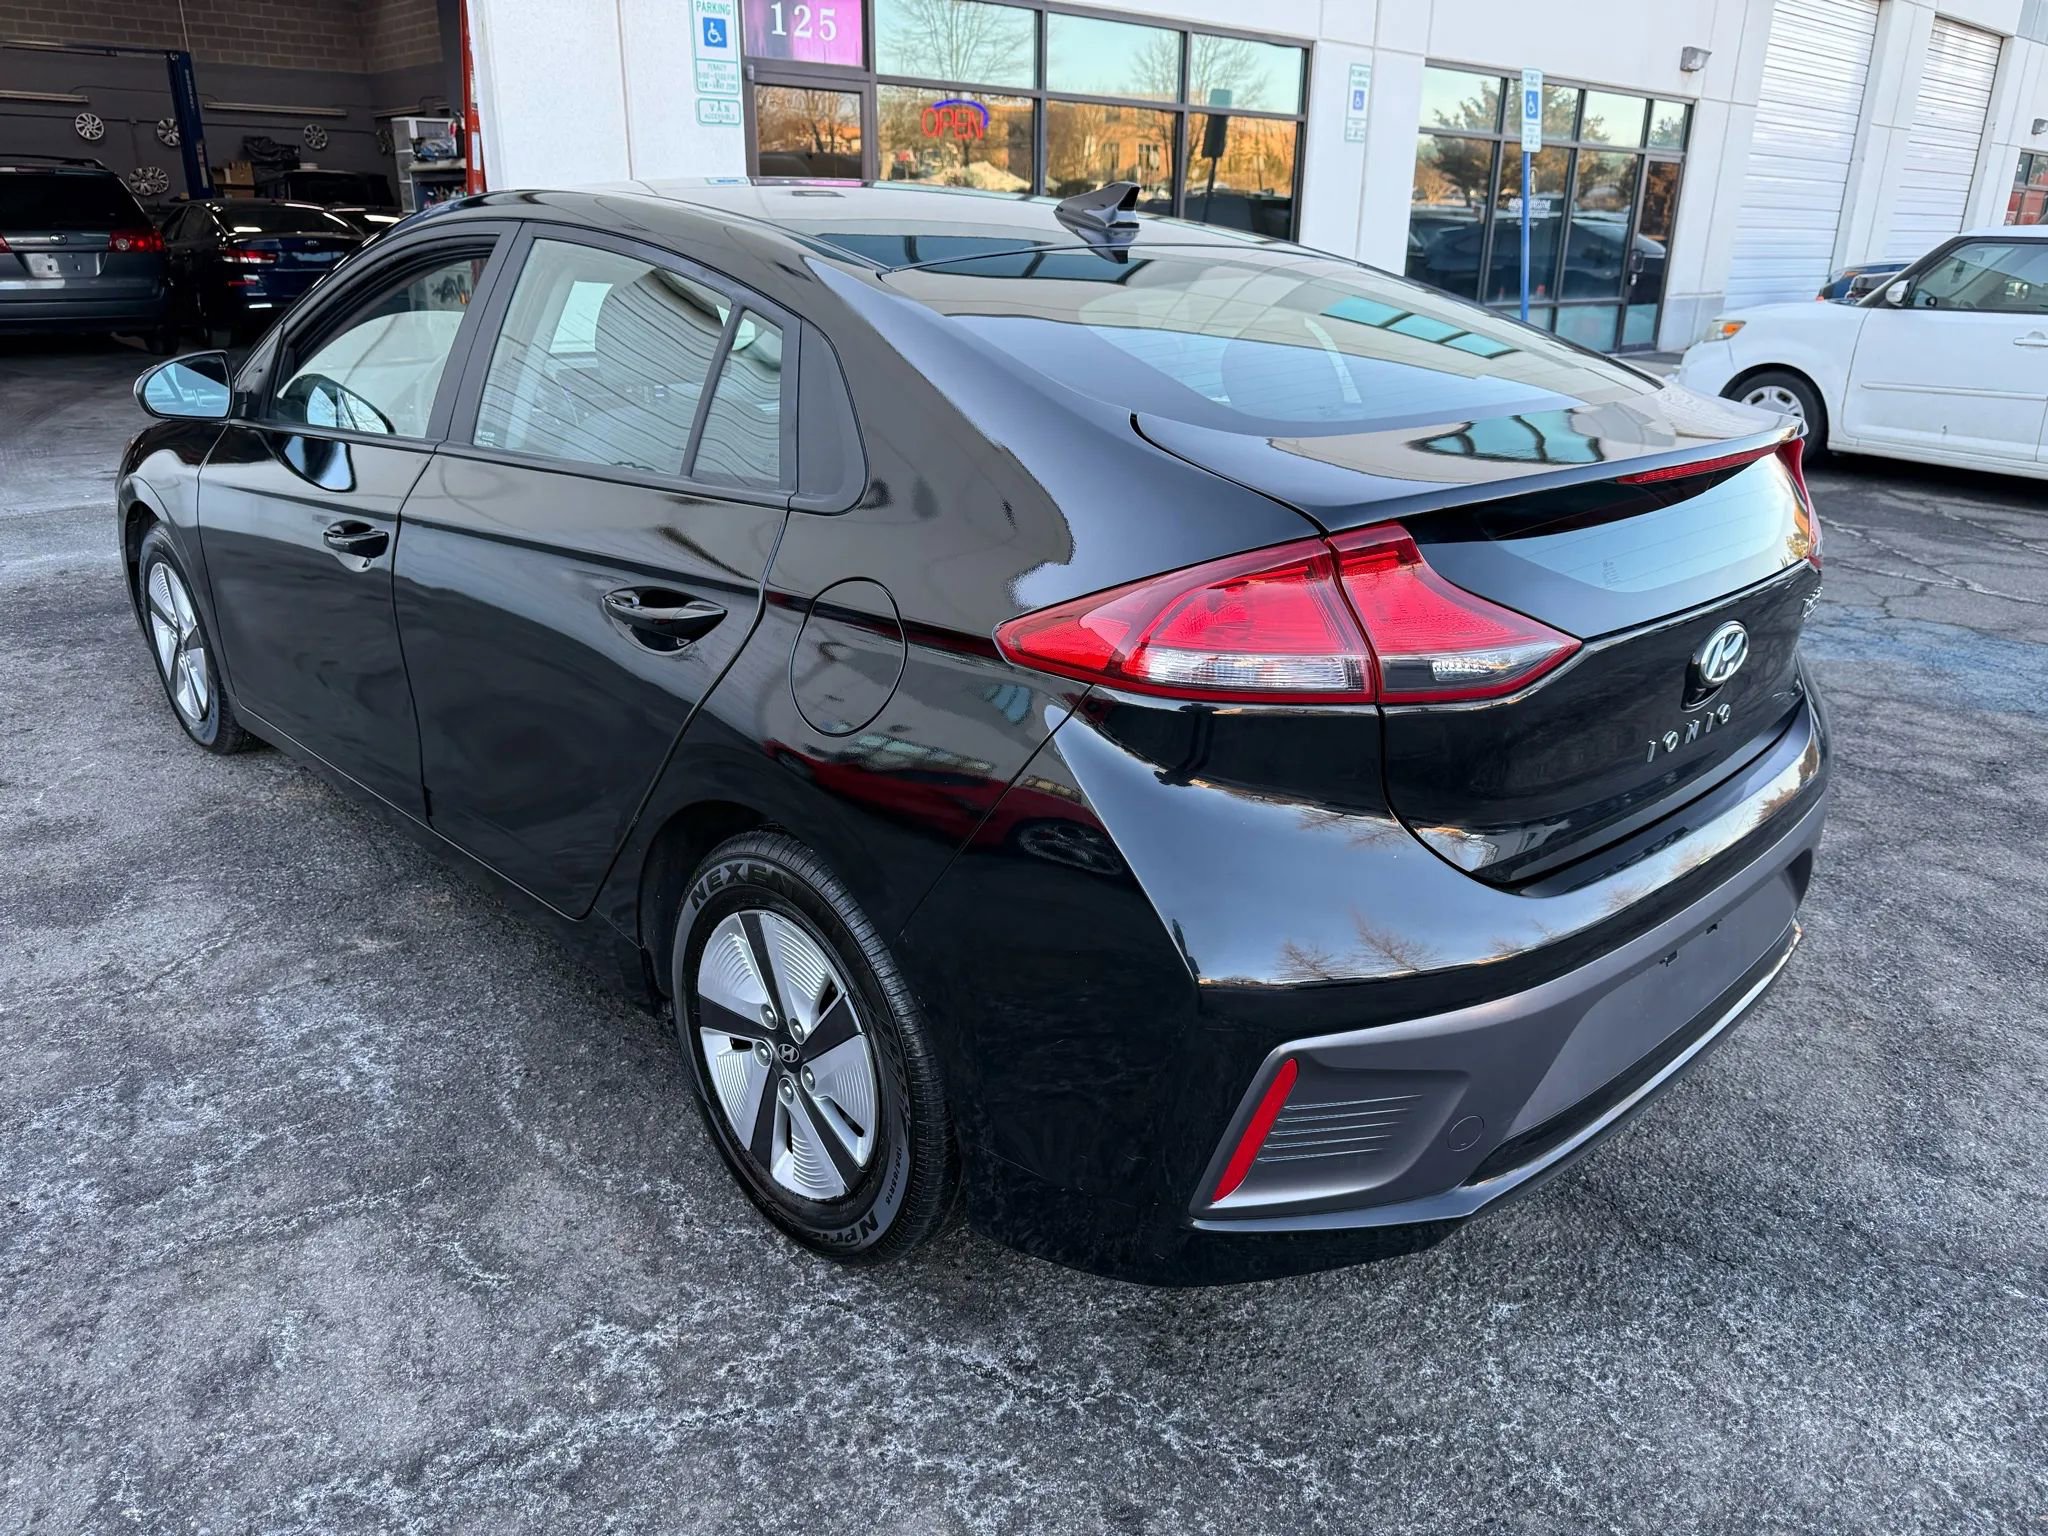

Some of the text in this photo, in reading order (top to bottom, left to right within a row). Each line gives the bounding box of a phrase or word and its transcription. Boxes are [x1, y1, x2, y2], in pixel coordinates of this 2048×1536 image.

[696, 1, 731, 16] PARKING
[770, 1, 837, 41] 125
[709, 103, 730, 112] VAN
[921, 107, 985, 141] OPEN
[1647, 703, 1731, 763] IONIQ
[690, 862, 794, 911] NEXEN
